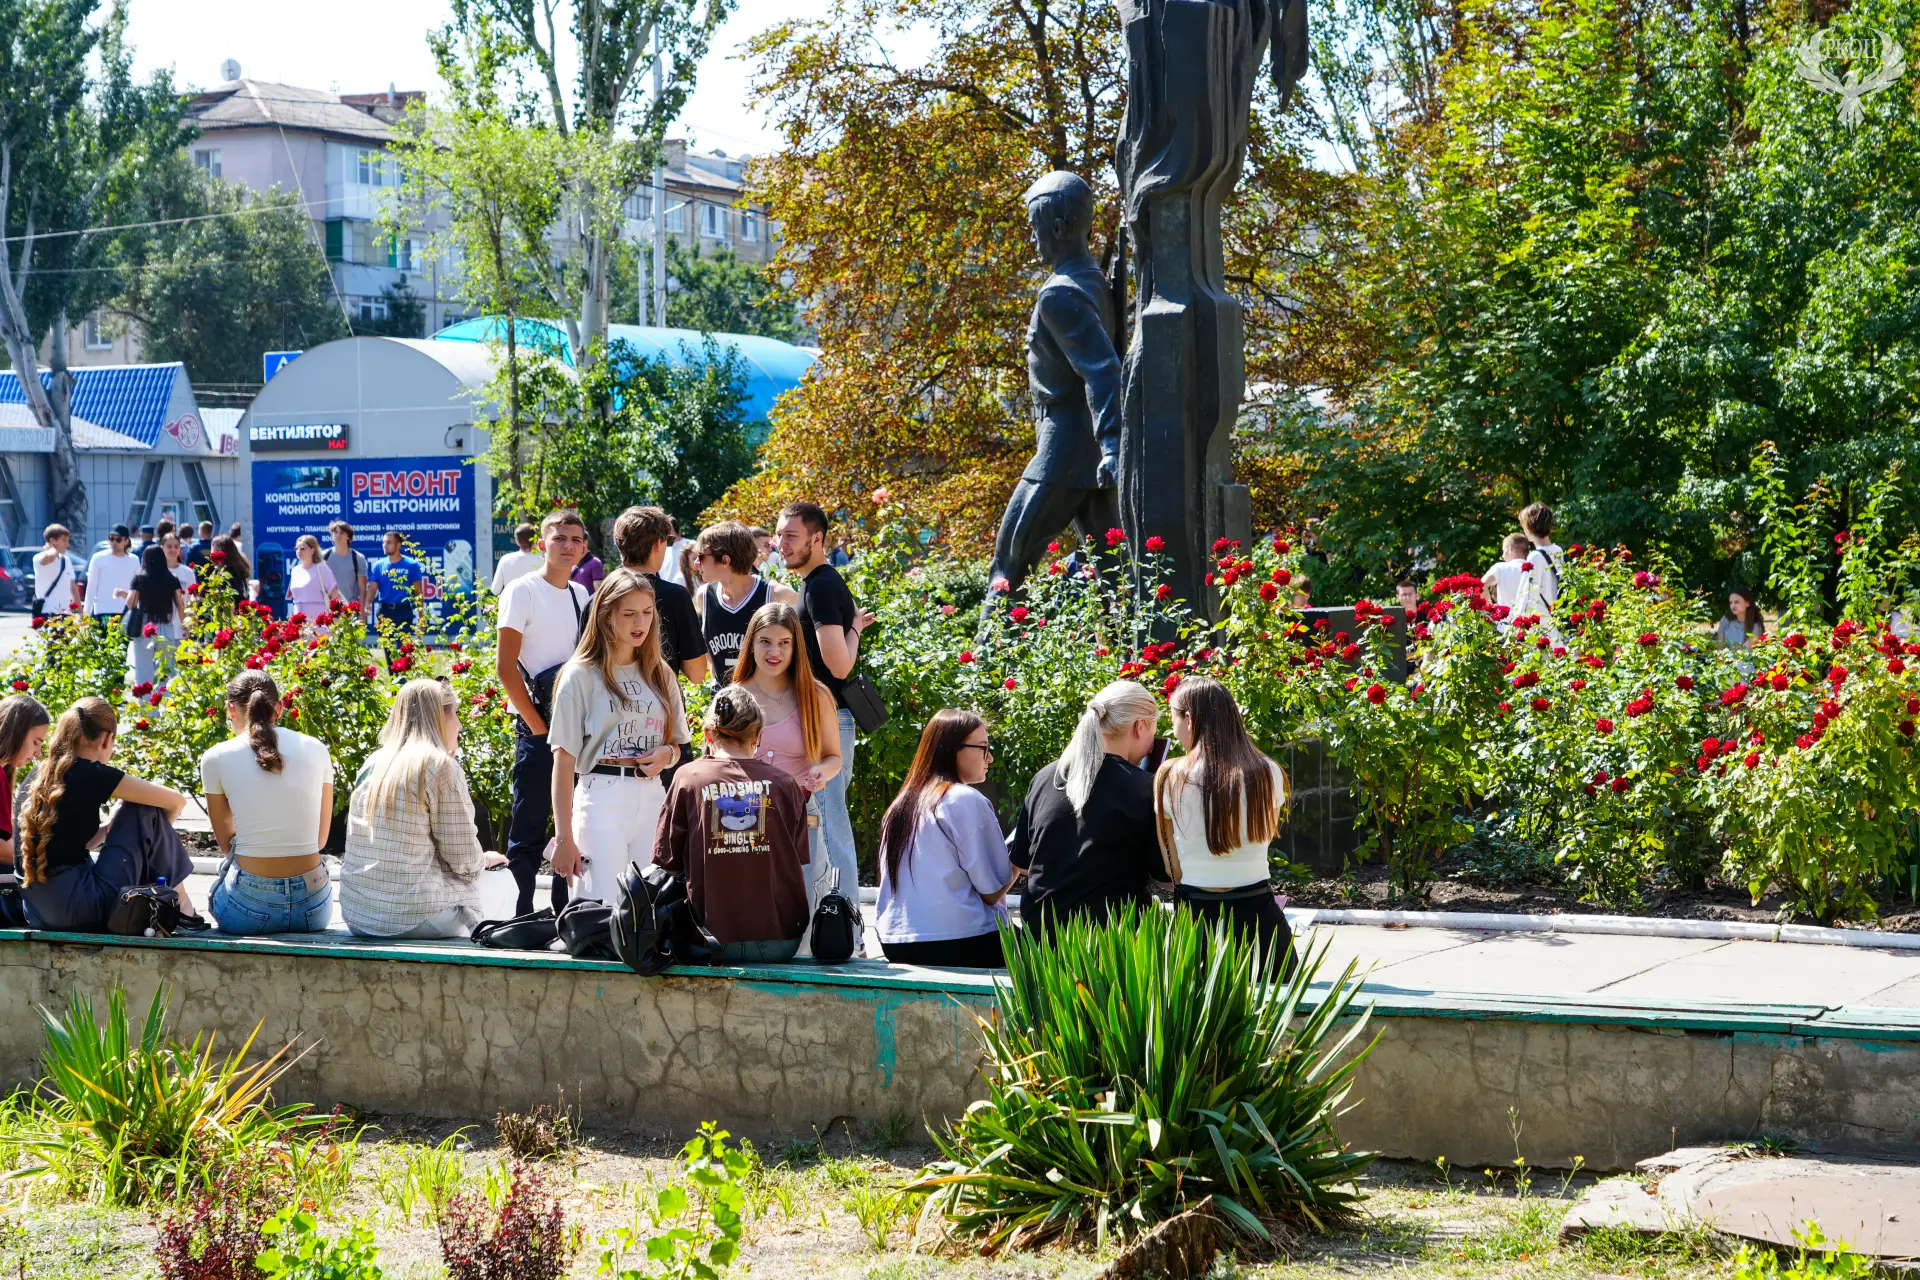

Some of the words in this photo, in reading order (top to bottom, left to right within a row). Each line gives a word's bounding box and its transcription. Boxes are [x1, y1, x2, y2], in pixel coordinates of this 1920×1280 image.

[249, 425, 342, 441] ВЕНТИЛЯТОР
[352, 469, 461, 498] РЕМОНТ
[265, 491, 341, 504] КОМПЬЮТЕРОВ
[353, 497, 460, 514] ЭЛЕКТРОНИКИ
[278, 503, 341, 515] МОНИТОРОВ
[617, 719, 638, 738] FOR
[701, 779, 773, 802] HEADSHOT
[723, 831, 756, 846] SINGLE
